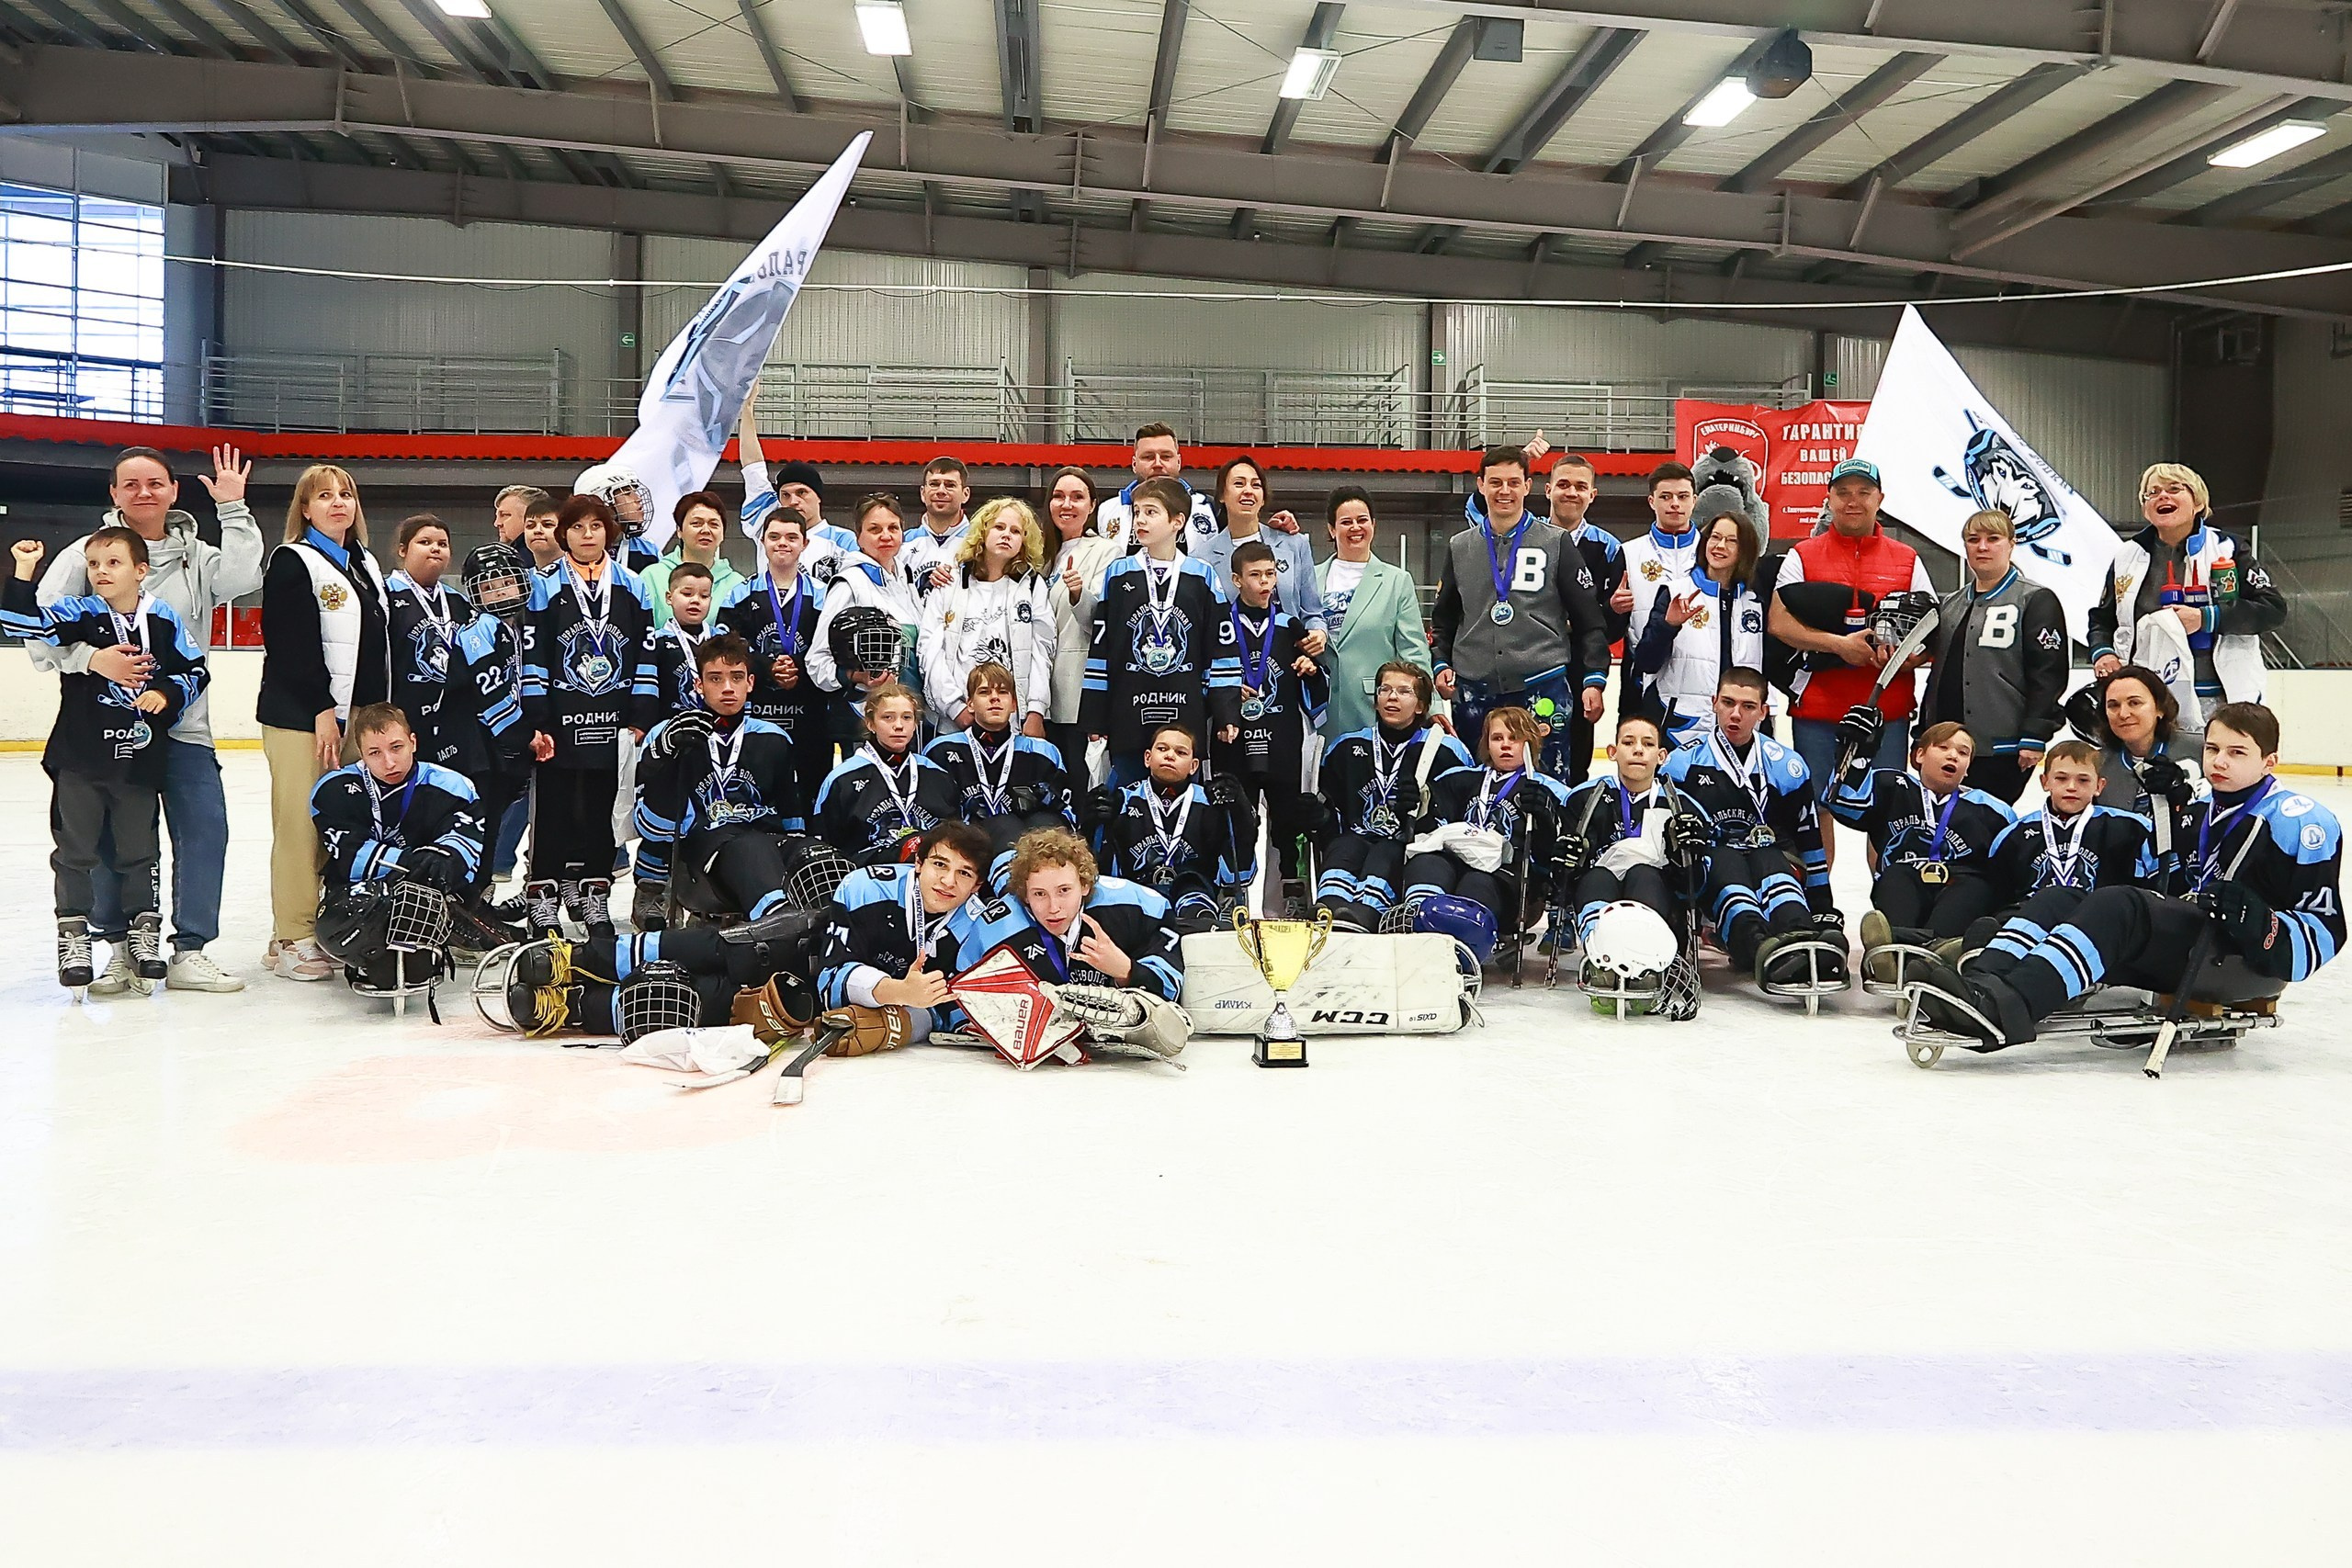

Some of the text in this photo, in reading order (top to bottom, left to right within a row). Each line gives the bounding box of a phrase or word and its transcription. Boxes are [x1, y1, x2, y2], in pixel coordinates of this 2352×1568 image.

[1701, 424, 1761, 439] ЕКАТЕРИНБУРГ
[1800, 446, 1849, 462] ВАШЕЙ
[1781, 471, 1831, 485] БЕЗОПАС
[1979, 604, 2019, 649] B
[476, 666, 503, 695] 22
[1133, 693, 1186, 706] РОДНИК
[752, 705, 805, 716] ОДНИК
[1012, 998, 1029, 1050] BAUER
[1311, 1010, 1390, 1025] CCM
